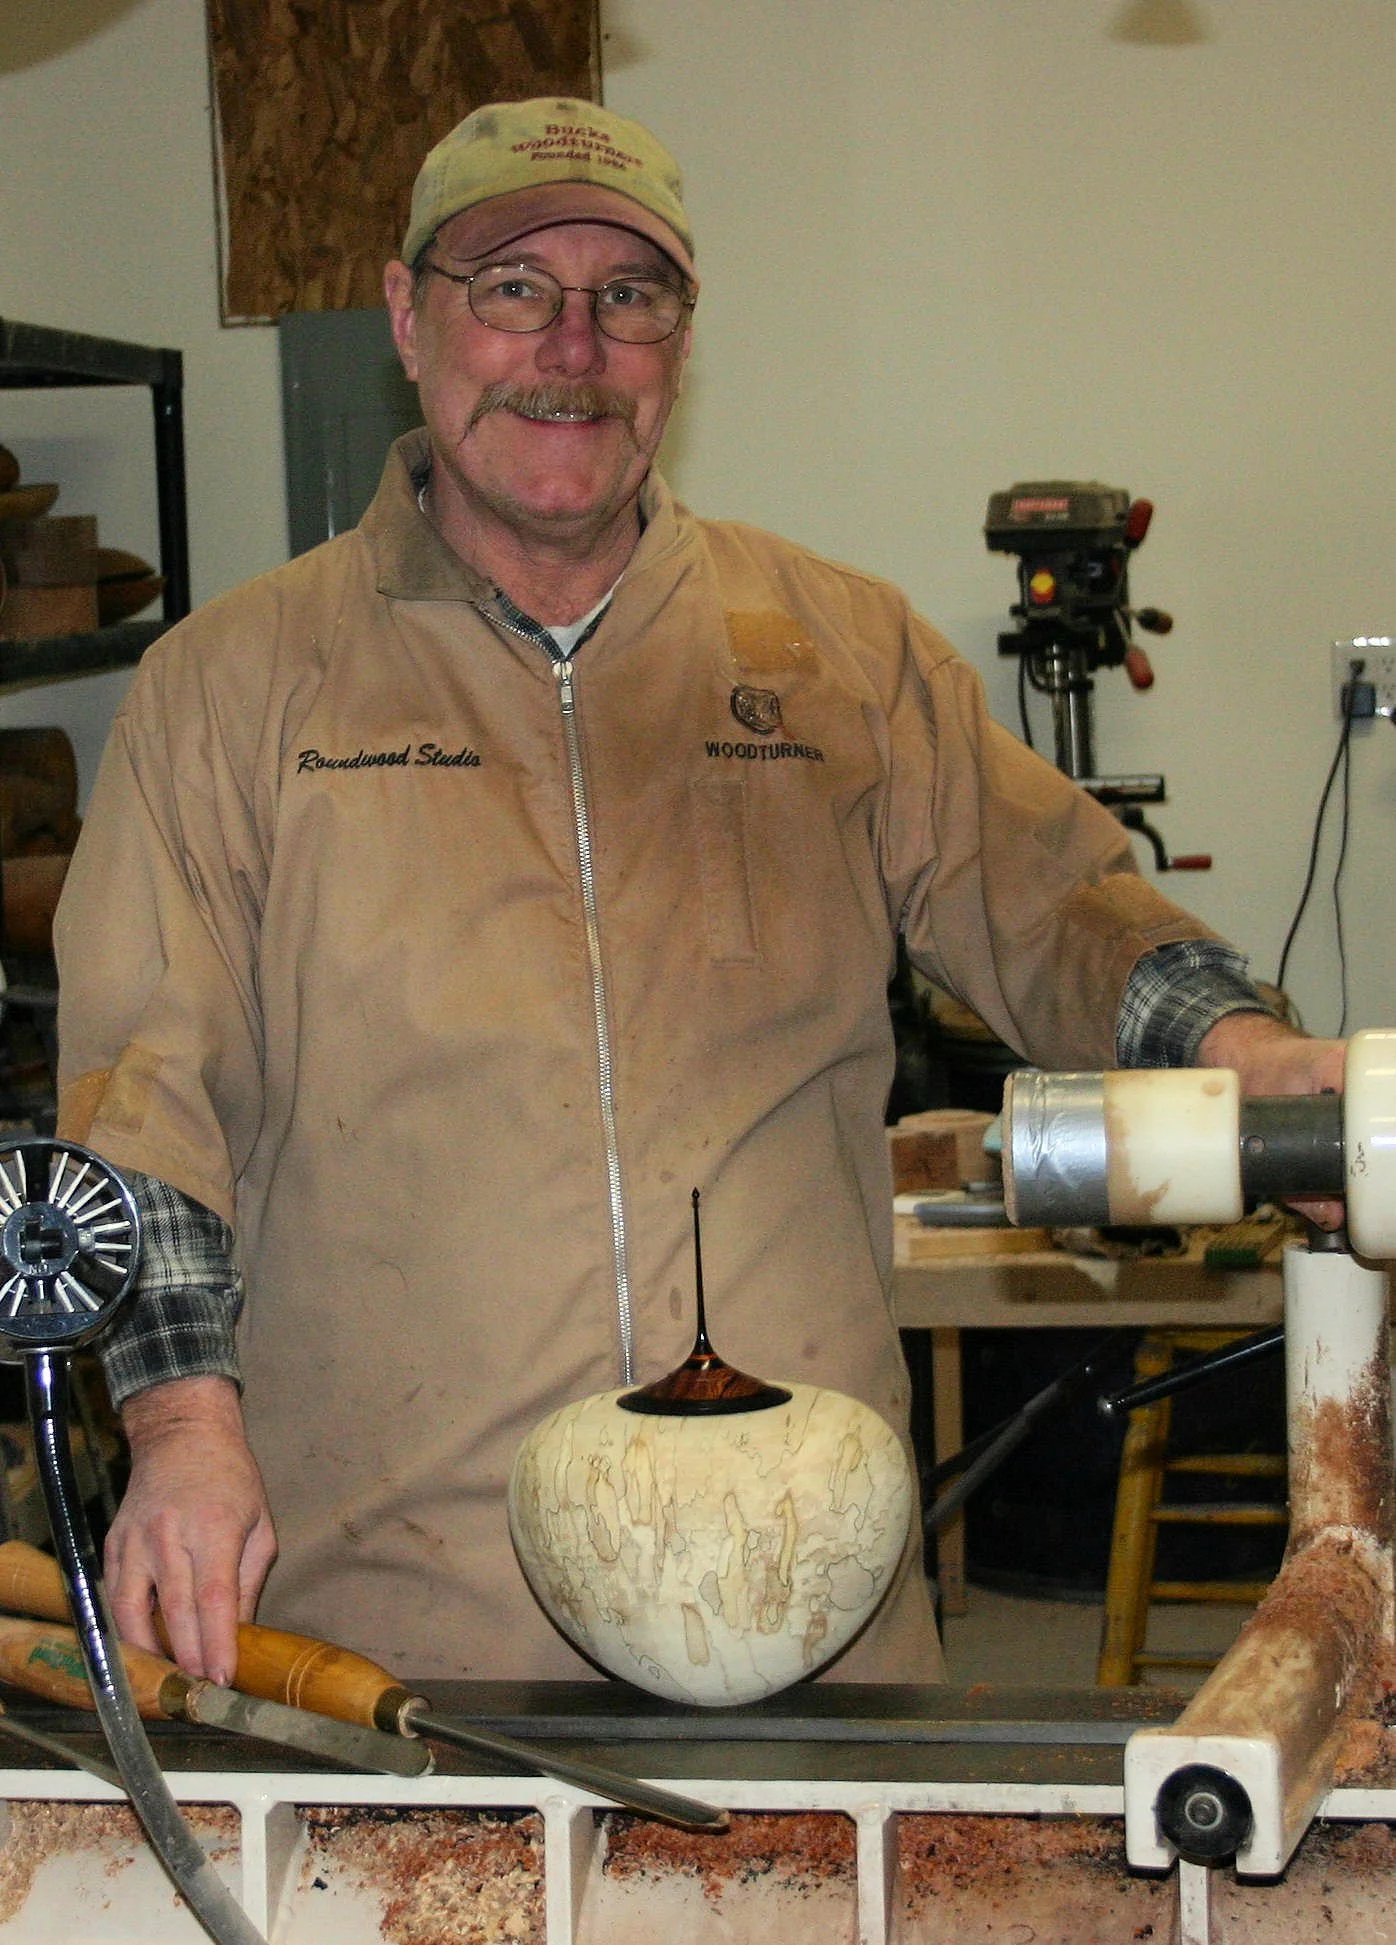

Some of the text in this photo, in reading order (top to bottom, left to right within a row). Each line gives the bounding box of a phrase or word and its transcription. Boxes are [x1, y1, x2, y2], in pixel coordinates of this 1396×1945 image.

[545, 124, 611, 143] Bucks
[511, 136, 643, 168] Woodturners
[530, 150, 590, 161] Founded
[297, 743, 481, 774] Roundwood Studio
[705, 741, 824, 762] WOODTURNER
